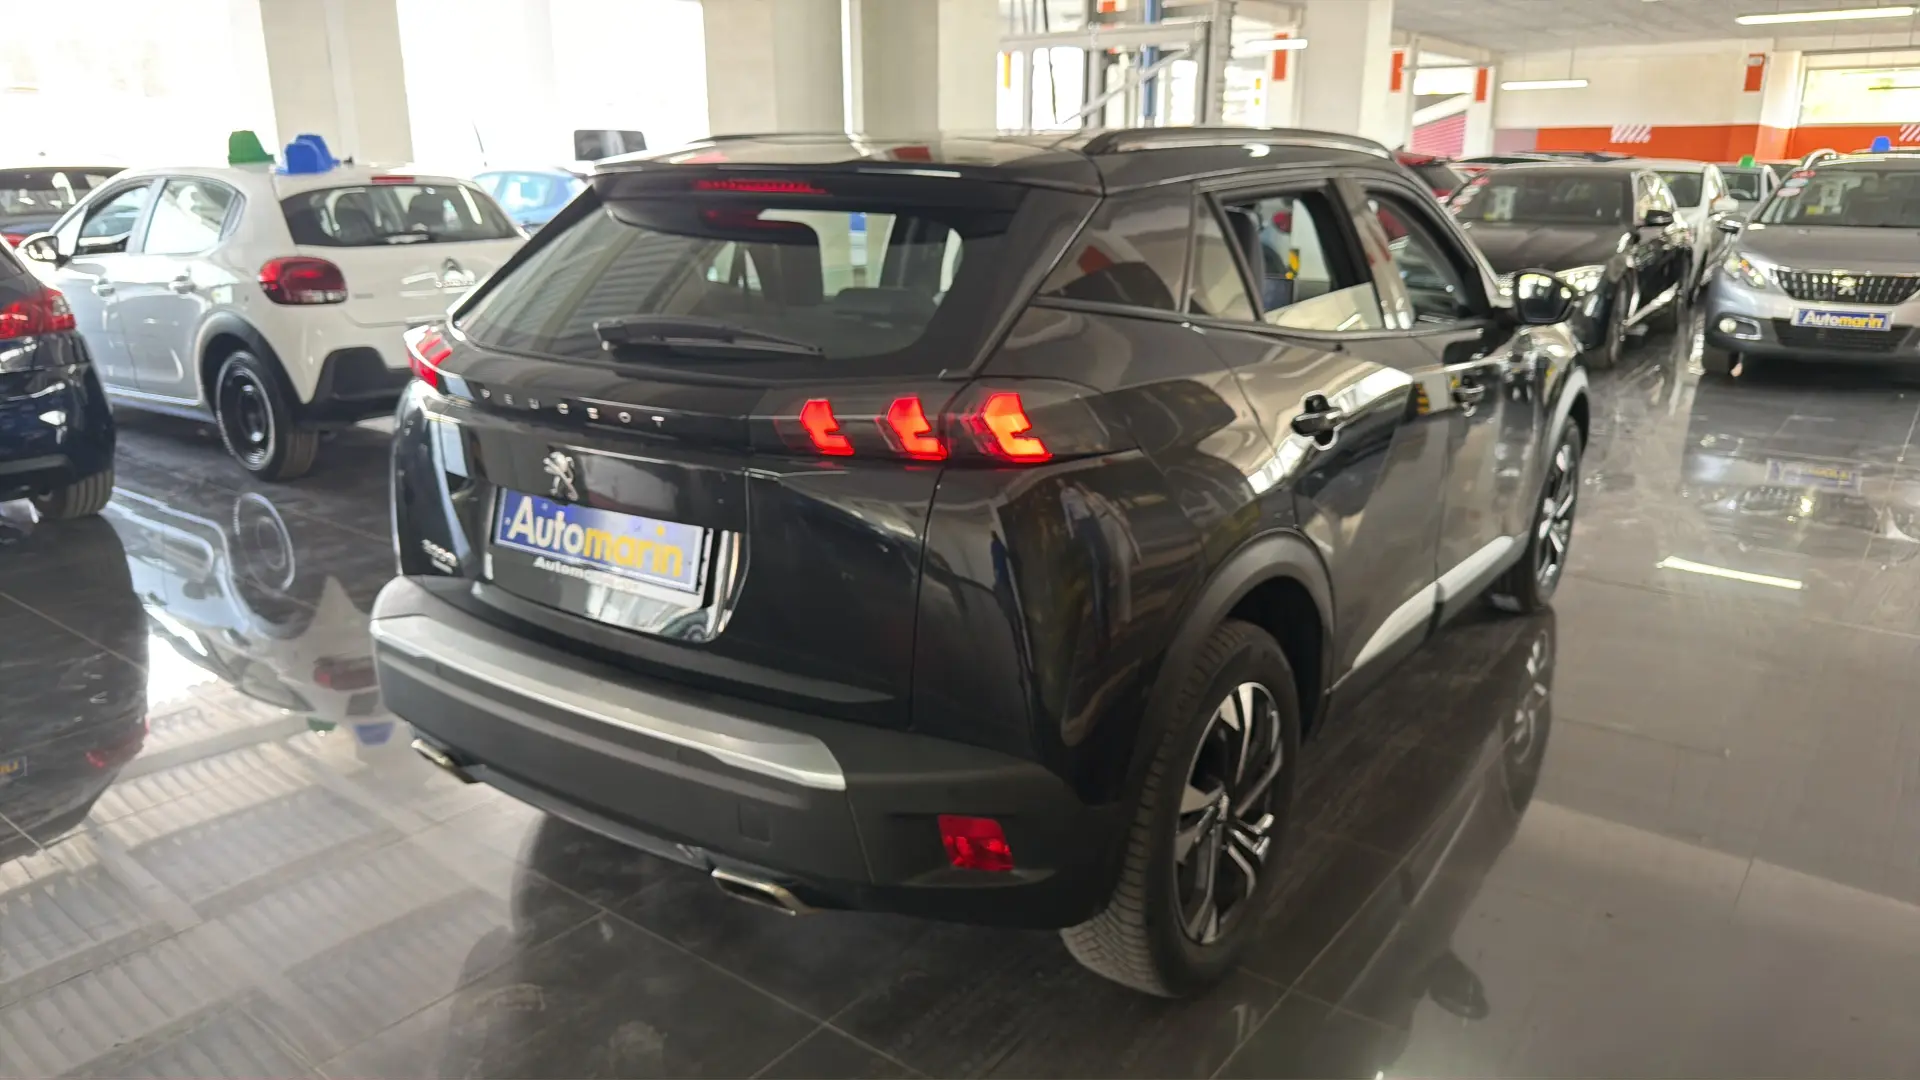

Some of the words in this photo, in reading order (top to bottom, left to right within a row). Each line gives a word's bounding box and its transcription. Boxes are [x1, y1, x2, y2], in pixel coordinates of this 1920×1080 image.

[1802, 309, 1885, 329] Automarin
[479, 388, 665, 429] PEUGEOT
[507, 495, 684, 578] Automarin
